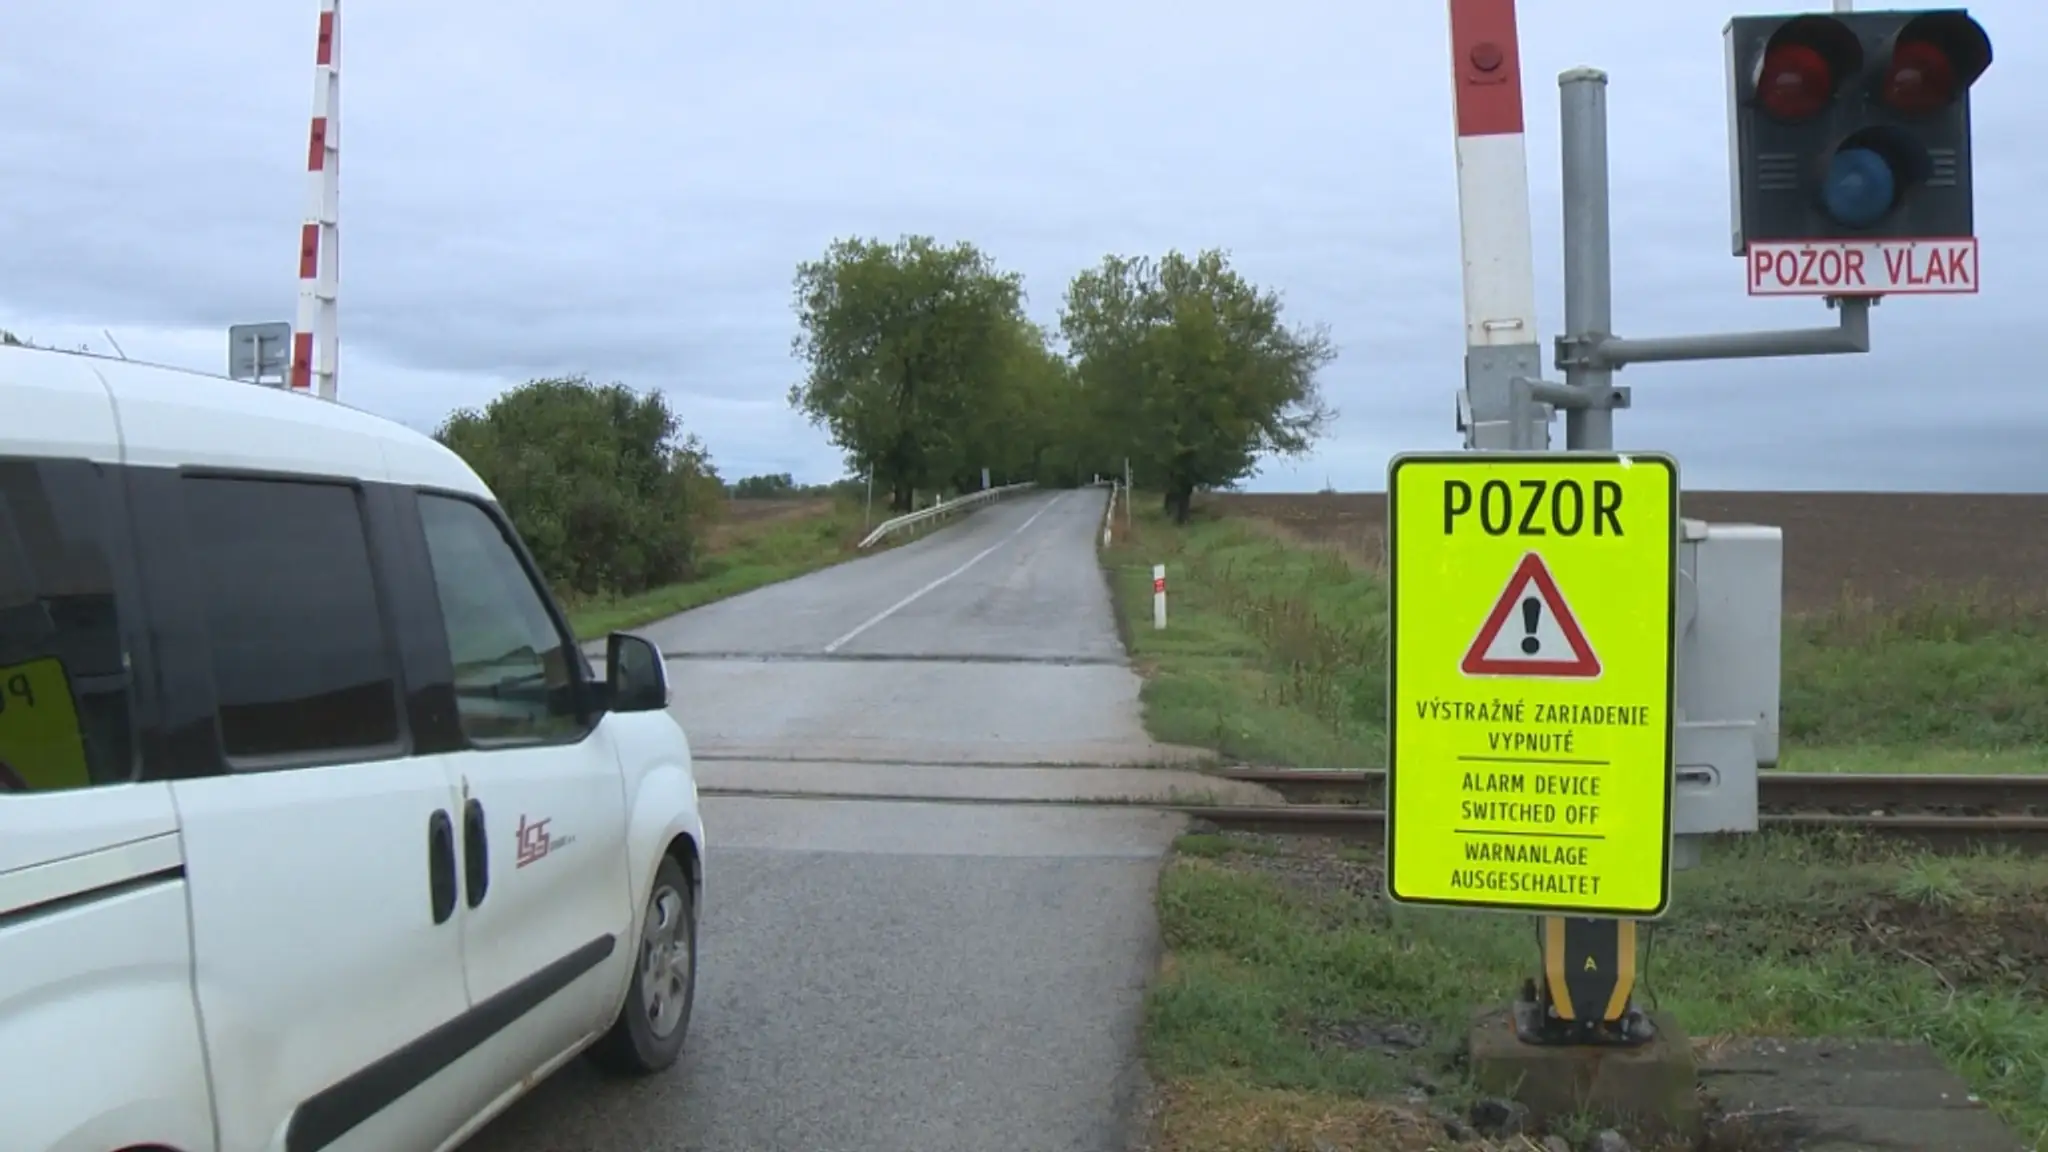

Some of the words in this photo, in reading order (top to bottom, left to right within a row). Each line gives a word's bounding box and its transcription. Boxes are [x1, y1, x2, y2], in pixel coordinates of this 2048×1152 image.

[1754, 249, 1866, 286] POZOR
[1884, 247, 1970, 285] VLAK
[1443, 479, 1625, 537] POZOR
[1416, 698, 1525, 723] VÝSTRAŽNÉ
[1534, 703, 1649, 726] ZARIADENIE
[1488, 729, 1574, 753] VYPNUTÉ
[1462, 772, 1525, 794] ALARM
[1535, 775, 1600, 796] DEVICE
[1461, 800, 1556, 824] SWITCHED
[1565, 805, 1600, 825] OFF
[1464, 841, 1588, 867] WARNANLAGE
[1450, 869, 1601, 896] AUSGESCHALTET
[1584, 956, 1597, 971] A
